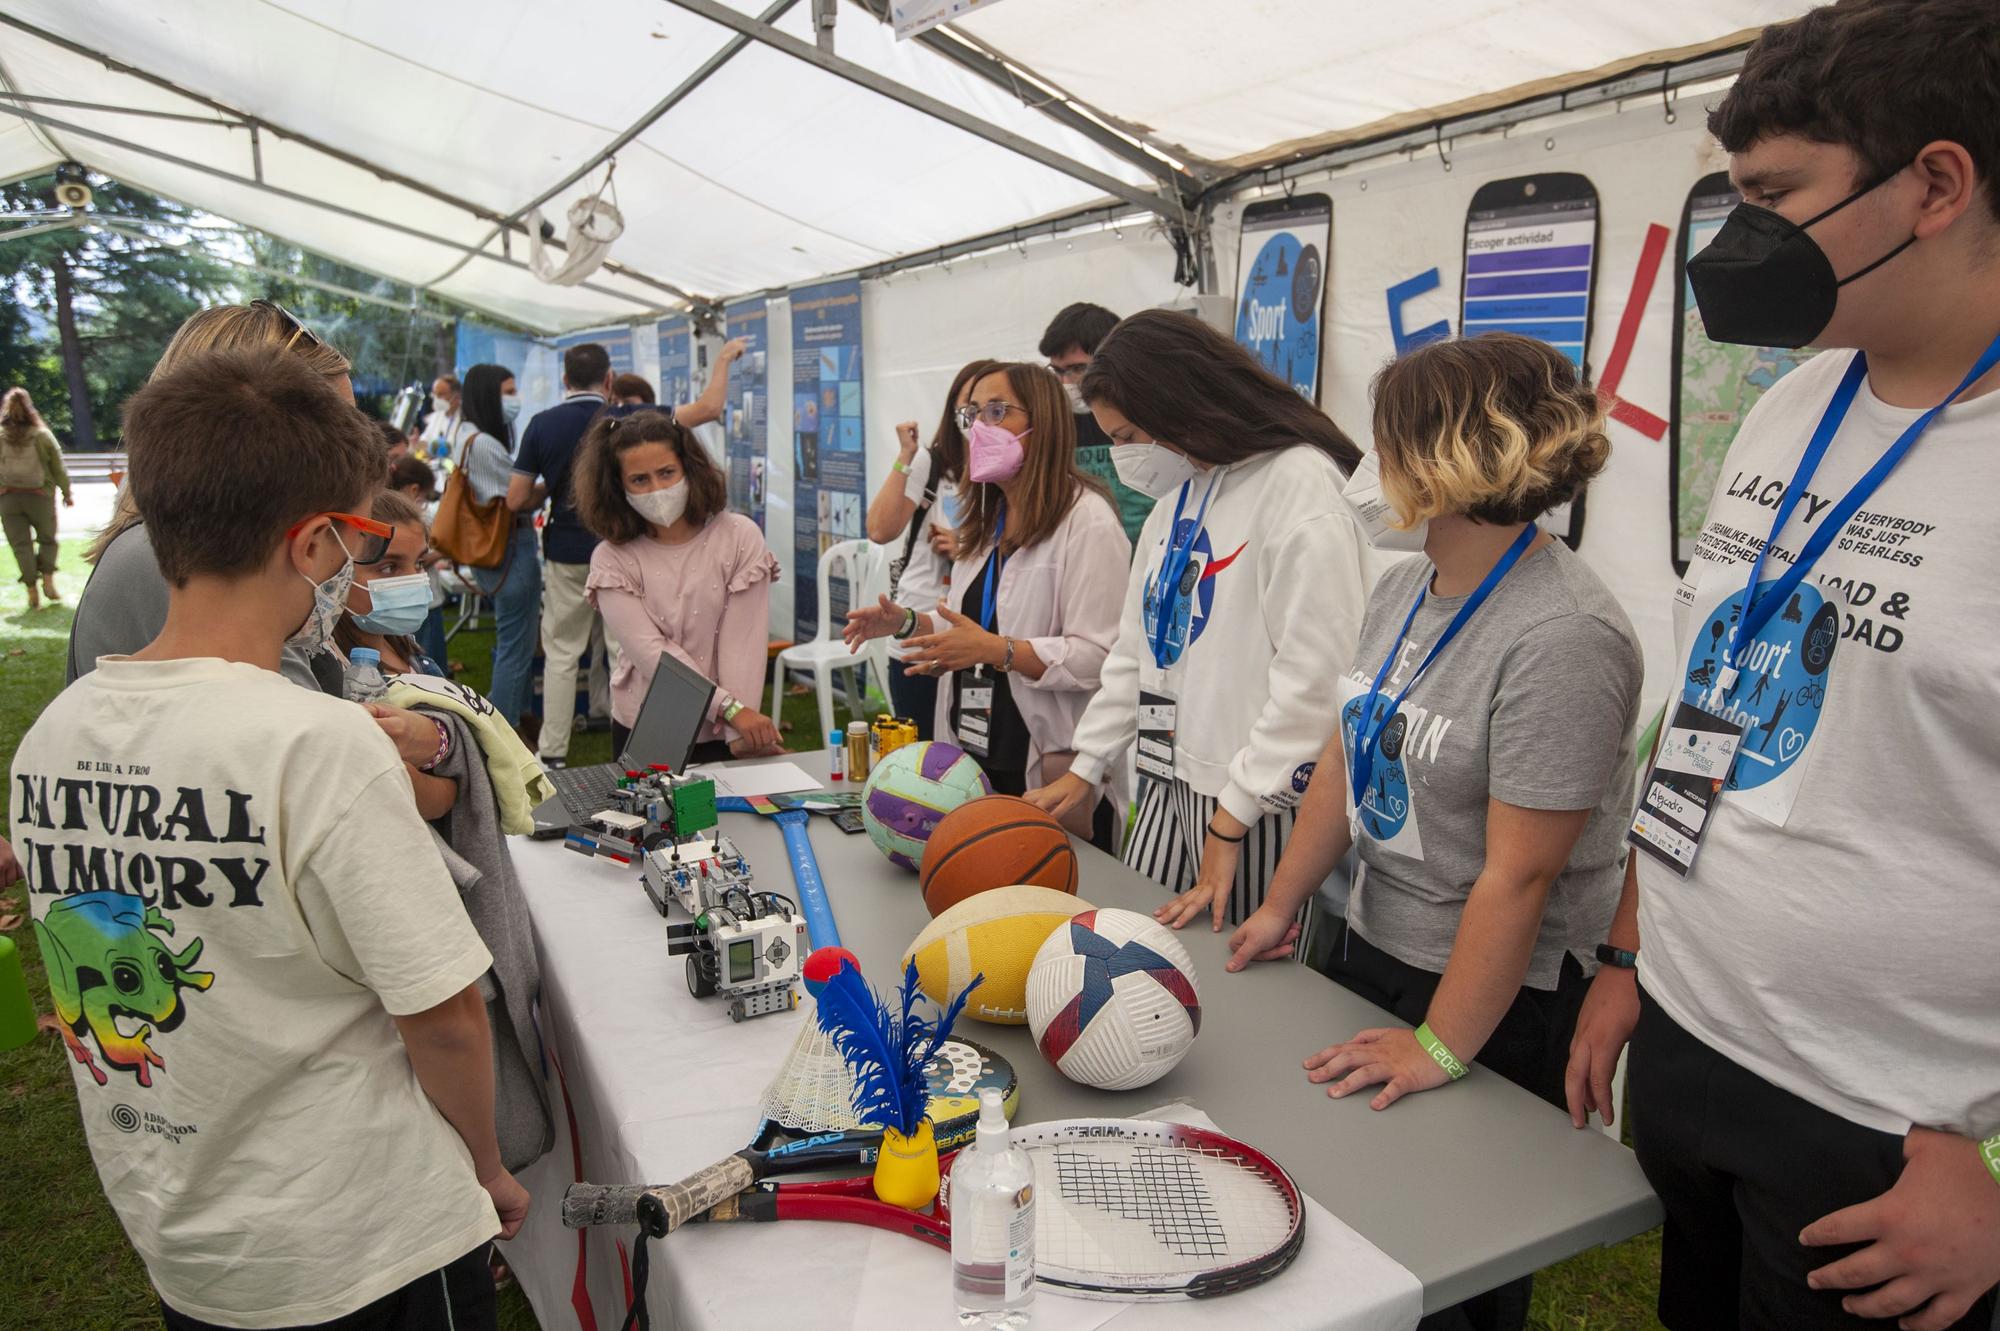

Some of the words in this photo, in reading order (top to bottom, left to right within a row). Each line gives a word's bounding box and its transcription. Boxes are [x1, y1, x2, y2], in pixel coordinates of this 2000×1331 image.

[1469, 236, 1505, 251] Escoger
[1507, 231, 1554, 246] actividad
[1248, 297, 1287, 350] Sport
[1846, 524, 1873, 539] WAS
[1872, 531, 1910, 546] JUST
[1854, 510, 1936, 536] EVERYBODY
[1713, 538, 1759, 564] DETACHED
[1838, 538, 1851, 551] SO
[1852, 542, 1923, 567] FEARLESS
[1880, 592, 1910, 620] &
[77, 760, 92, 771] BE
[115, 764, 122, 774] A
[1428, 1041, 1460, 1074] 2021
[1078, 1125, 1121, 1138] WIDE
[768, 1132, 845, 1158] HEAD
